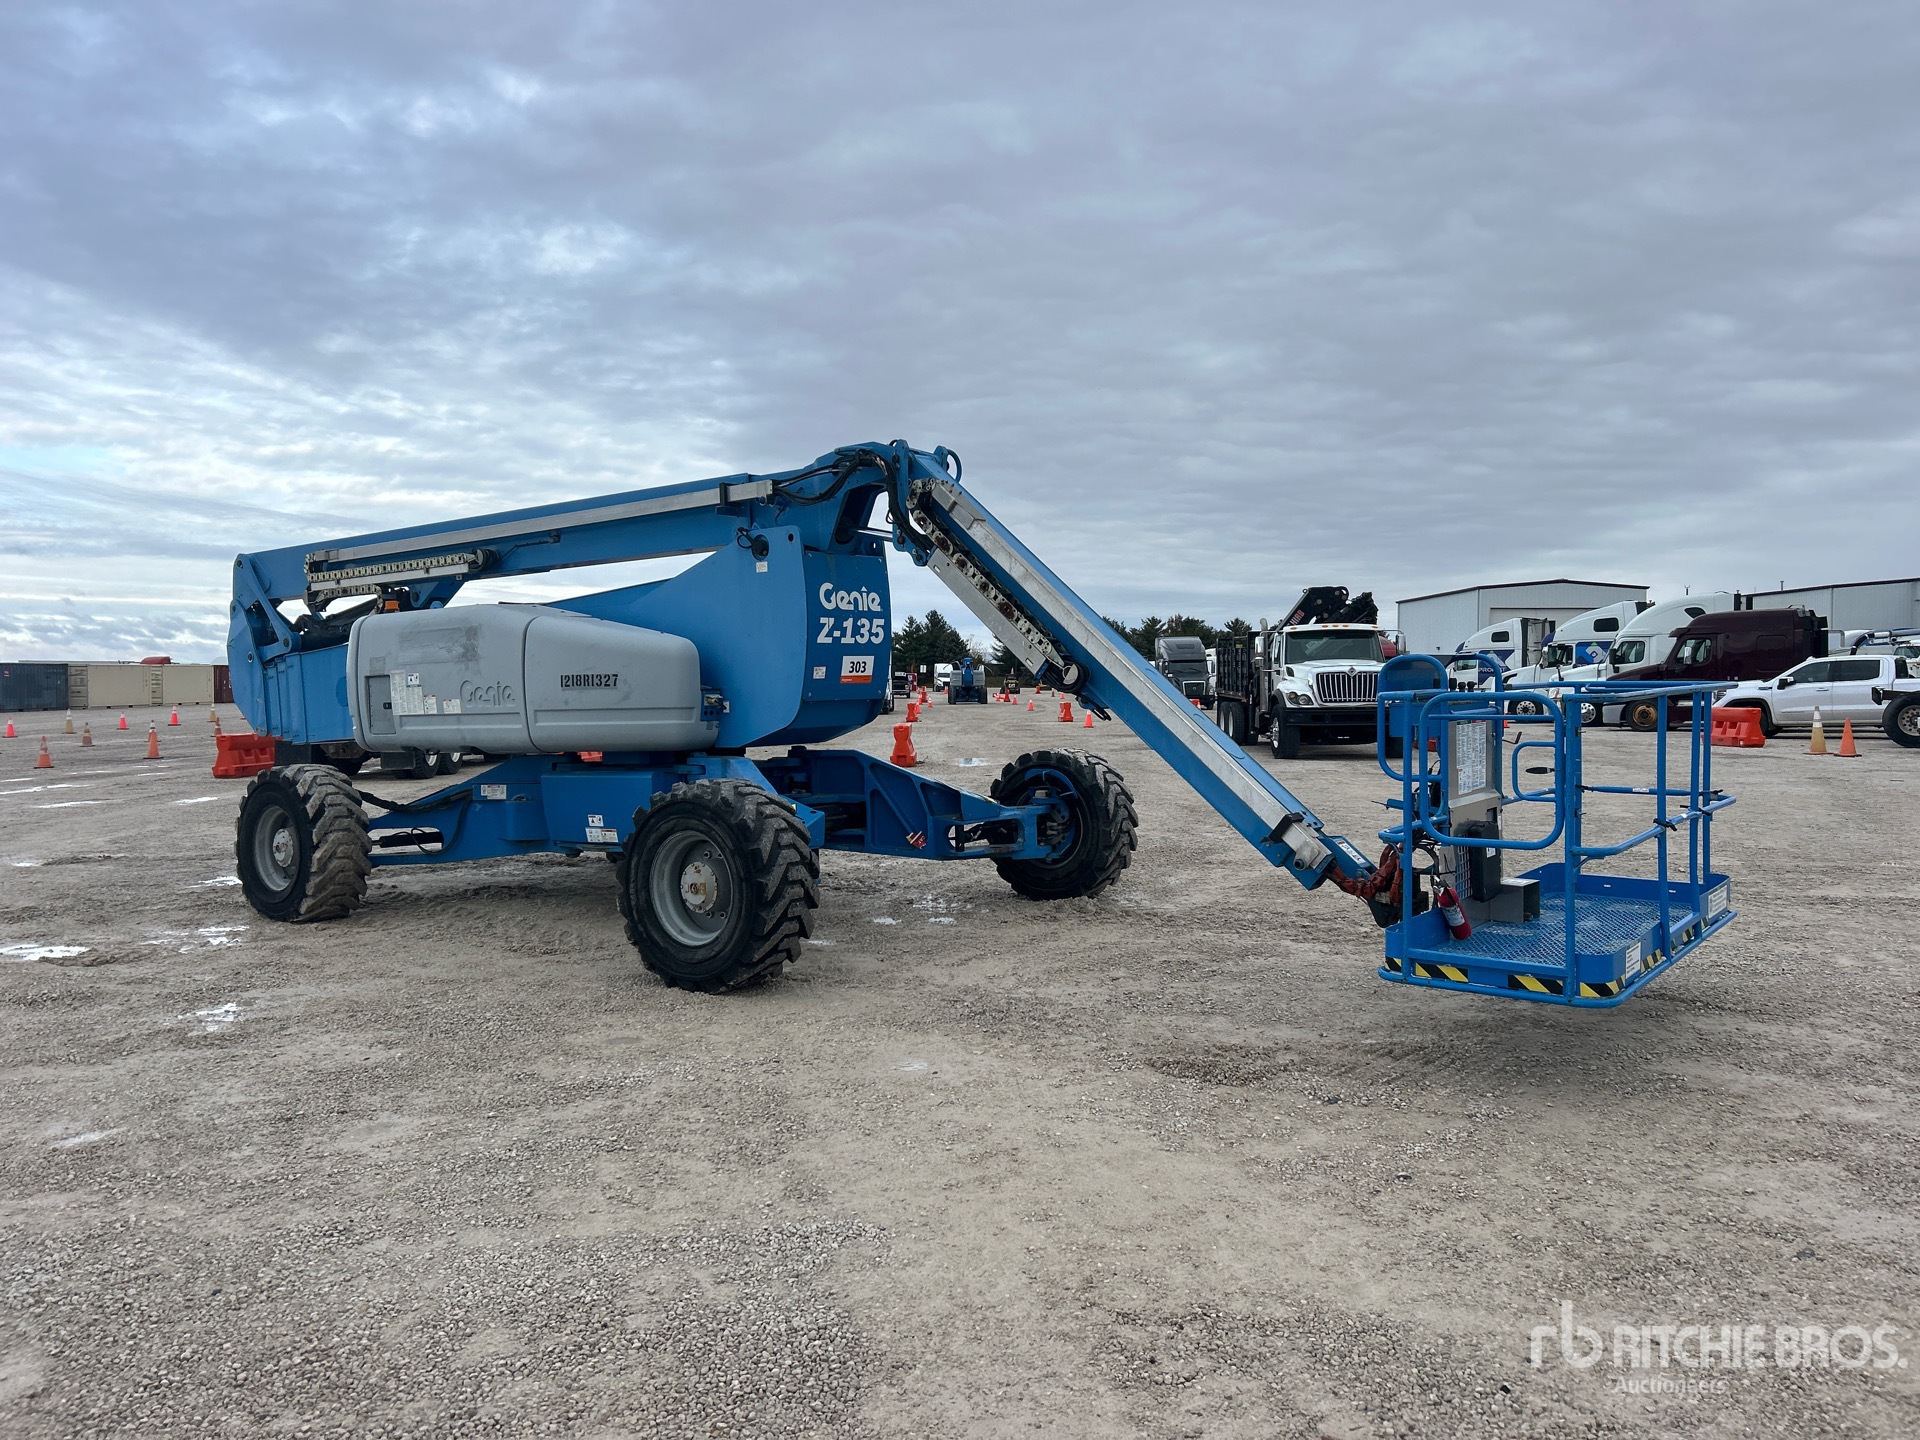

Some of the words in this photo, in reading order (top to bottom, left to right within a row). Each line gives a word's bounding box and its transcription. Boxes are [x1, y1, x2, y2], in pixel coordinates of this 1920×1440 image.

[819, 582, 881, 611] Genie
[816, 617, 885, 644] Z-135
[848, 660, 867, 673] 303
[560, 673, 619, 688] 1218R1327
